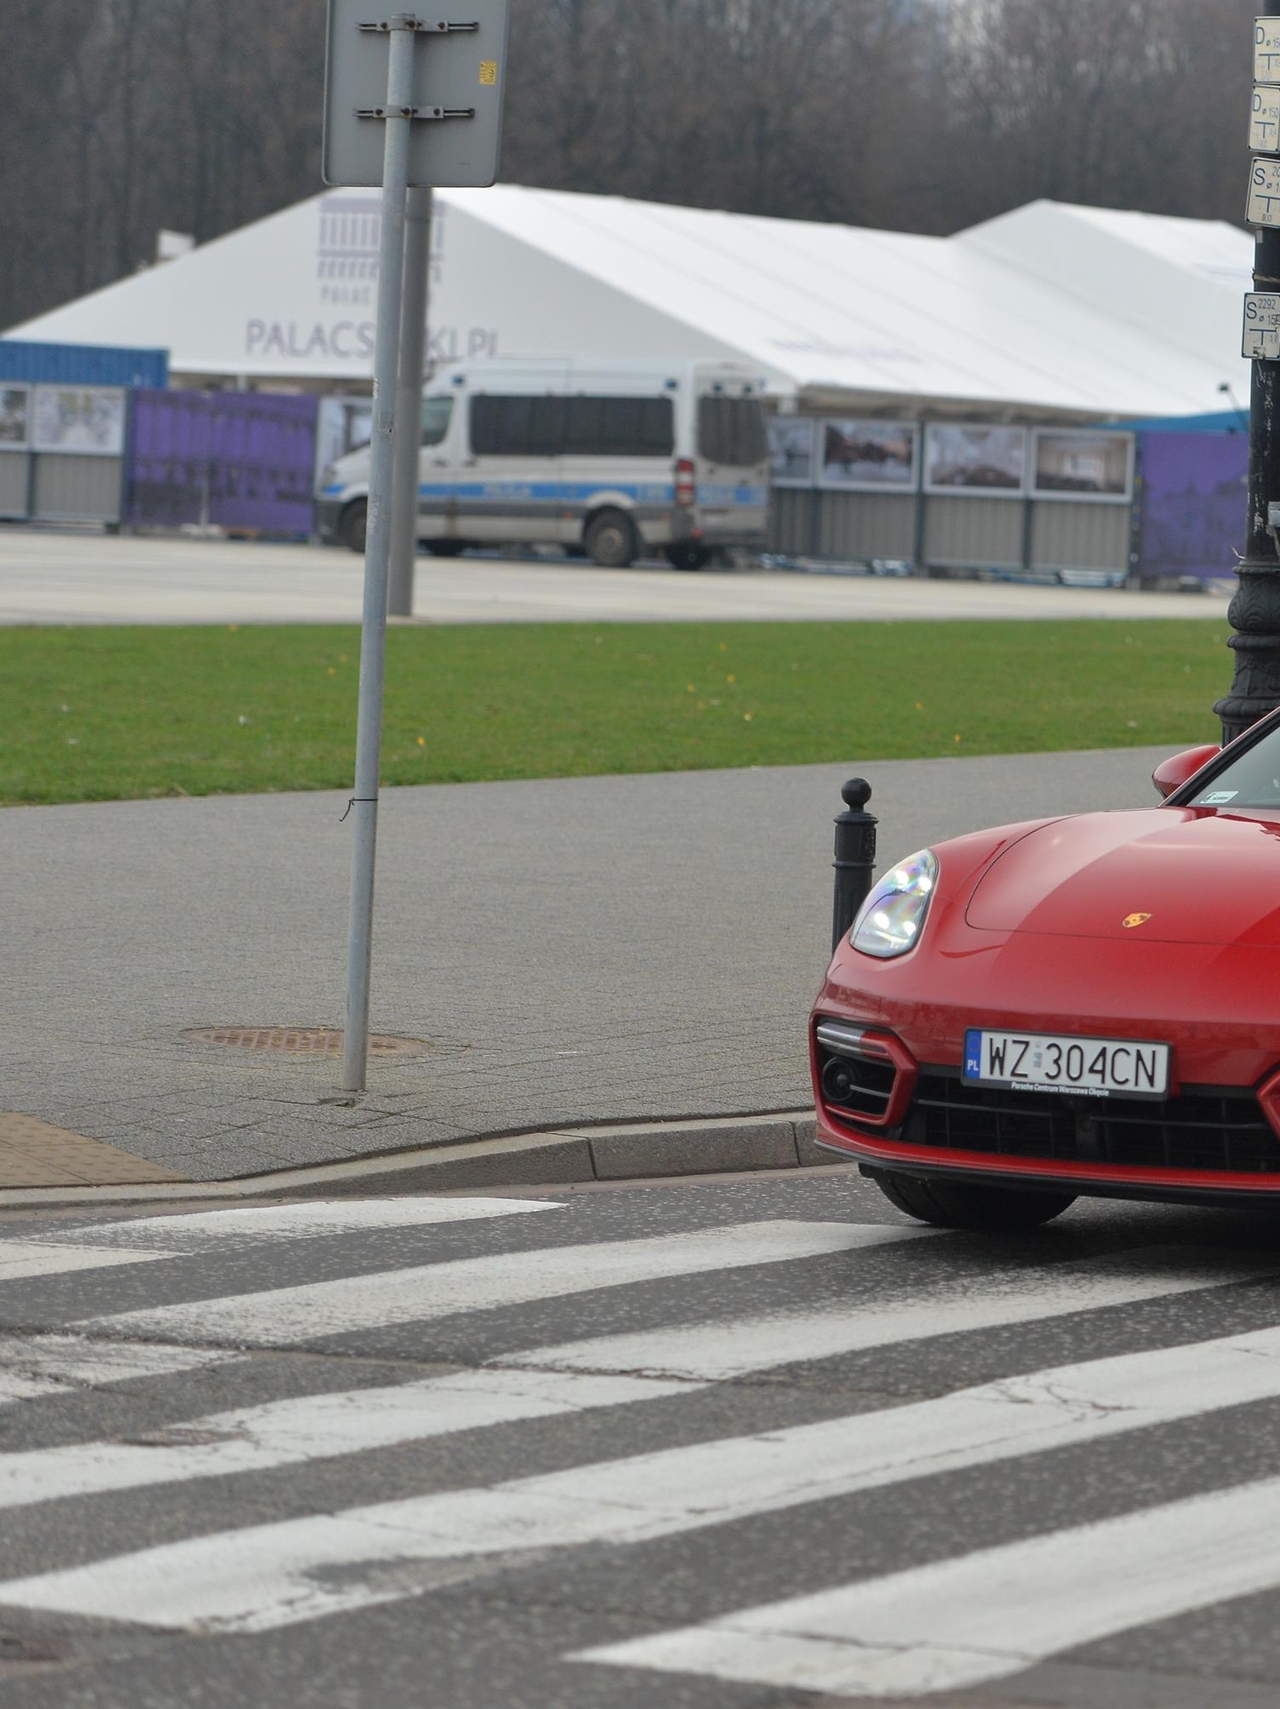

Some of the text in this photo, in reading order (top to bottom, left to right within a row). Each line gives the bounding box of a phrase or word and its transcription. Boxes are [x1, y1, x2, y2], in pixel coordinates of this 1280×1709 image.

[1253, 168, 1266, 186] S
[1246, 301, 1258, 320] S
[967, 1060, 979, 1071] PL
[989, 1037, 1030, 1078] WZ
[1045, 1043, 1156, 1088] 304CN
[1011, 1082, 1034, 1091] Porsche
[1034, 1084, 1059, 1093] Centrum
